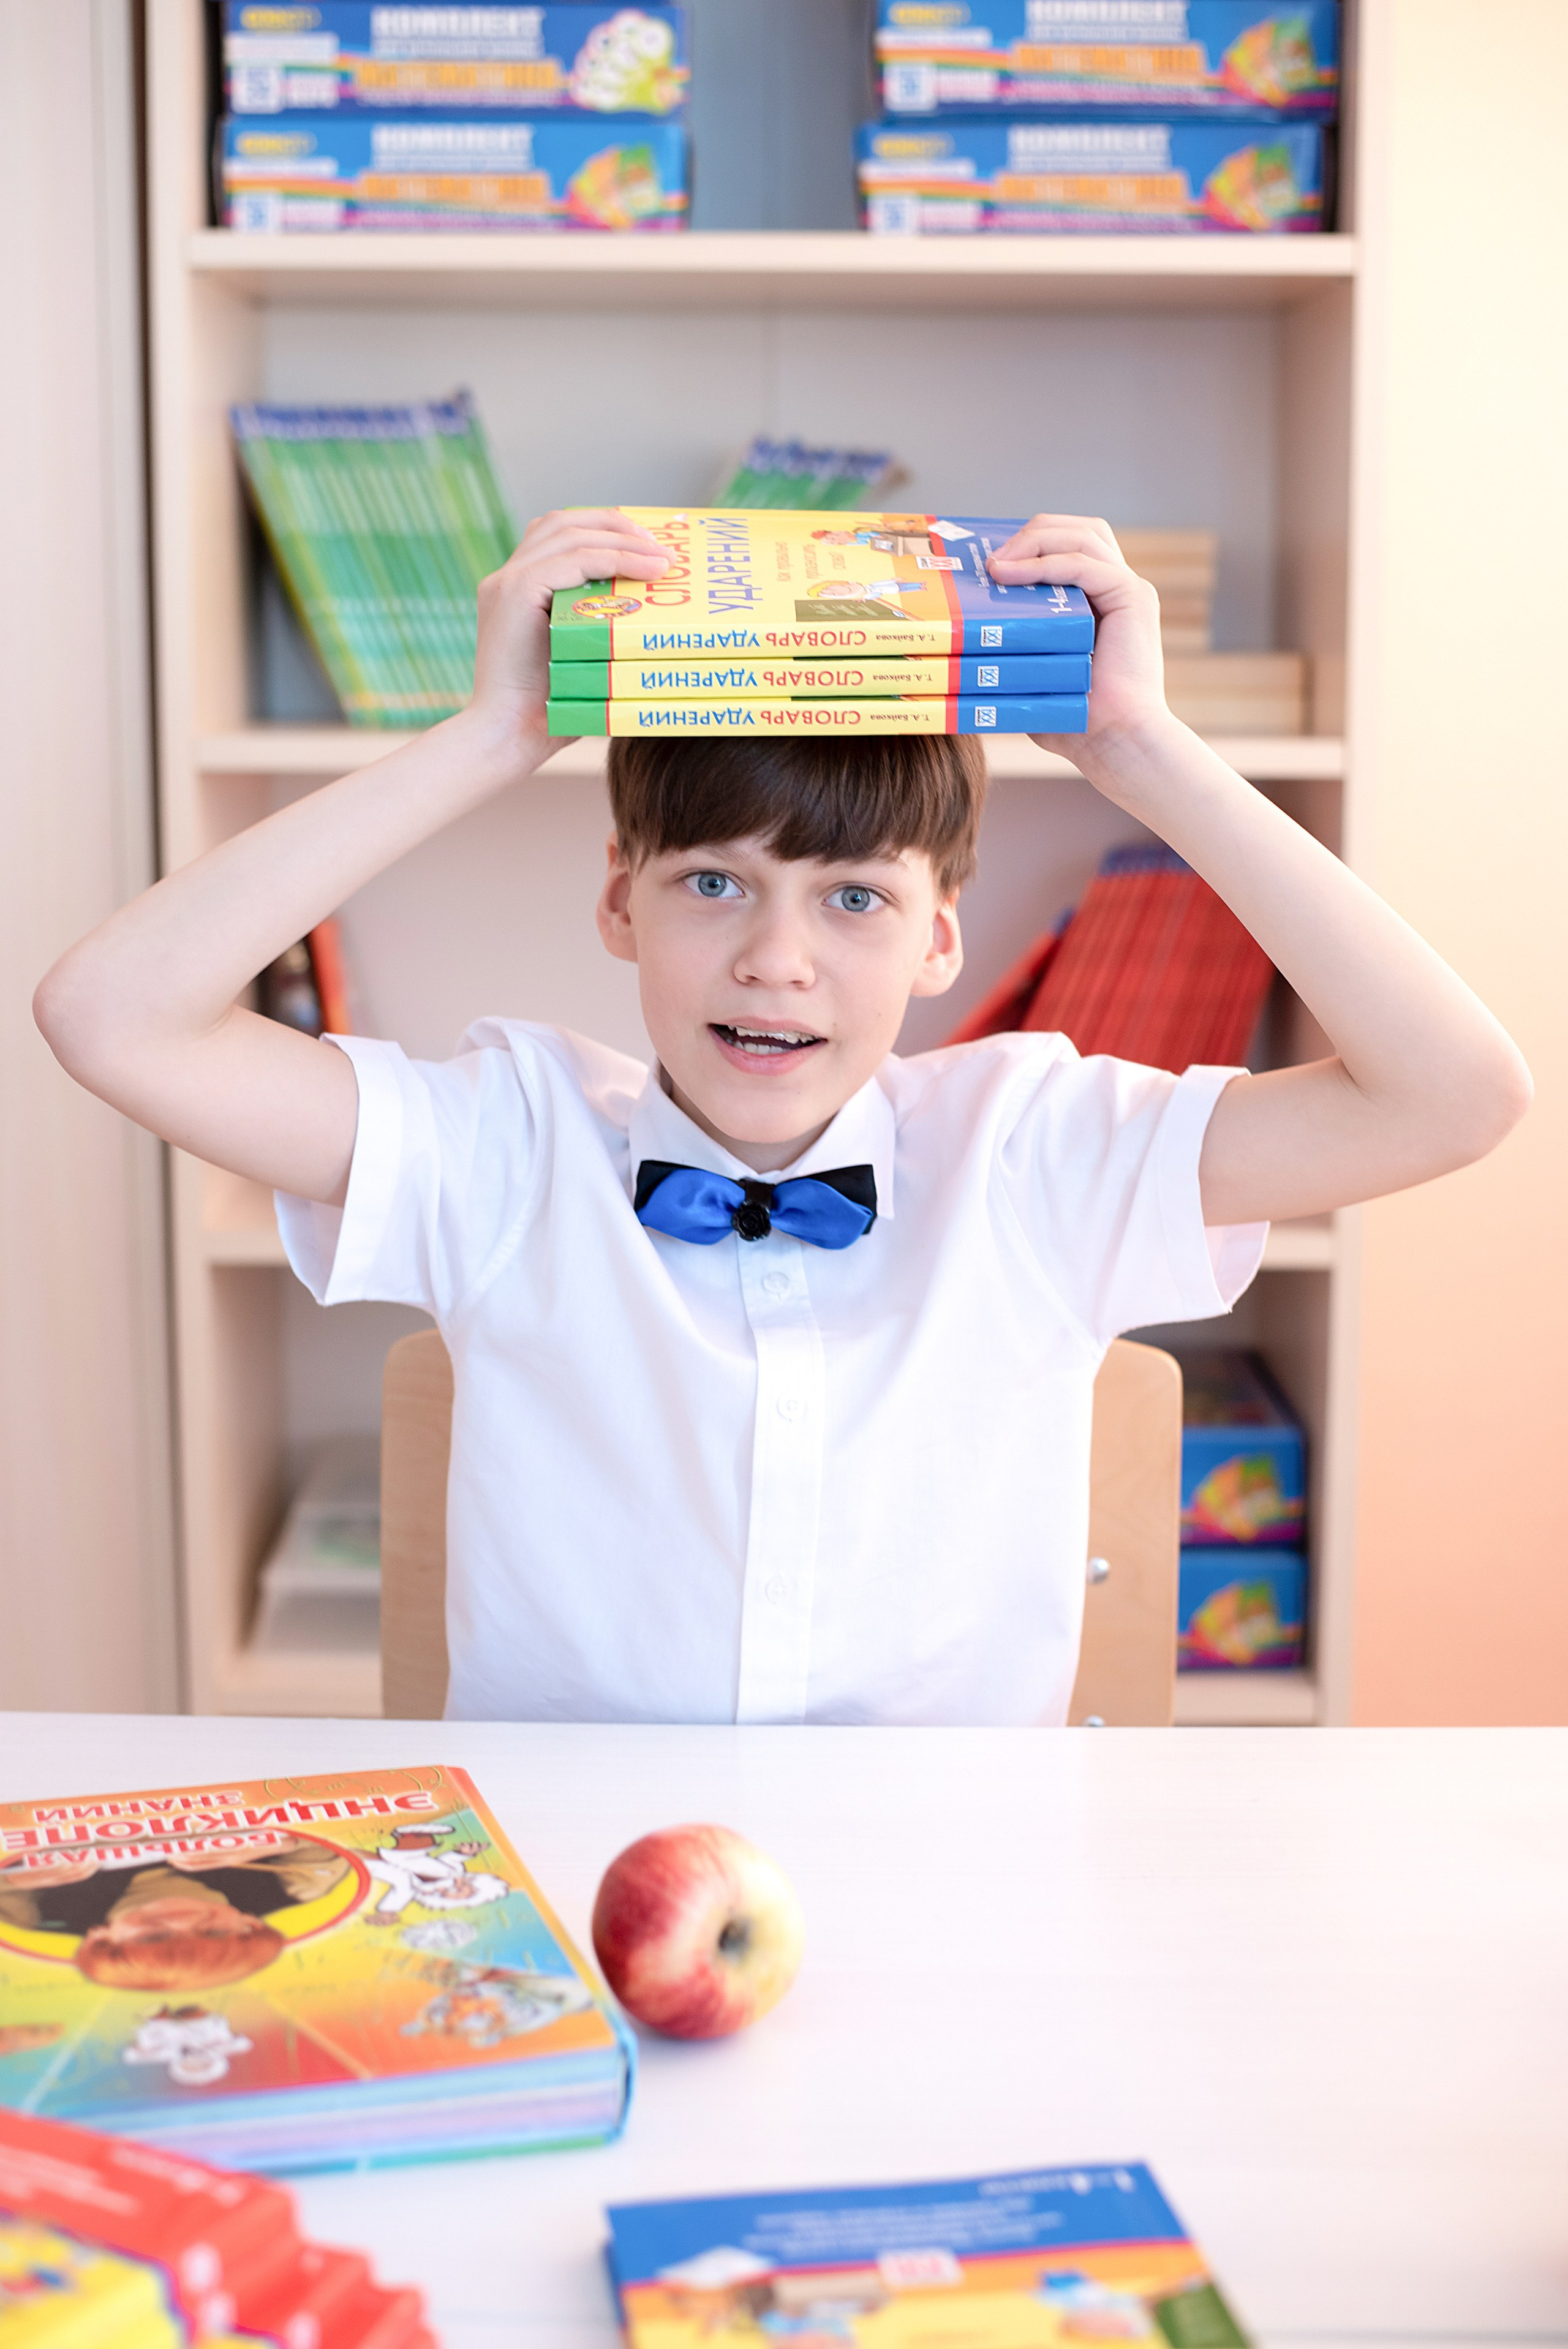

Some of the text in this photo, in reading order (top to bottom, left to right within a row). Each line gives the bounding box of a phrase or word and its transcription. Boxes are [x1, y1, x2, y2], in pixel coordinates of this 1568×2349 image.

[698, 518, 763, 614] УДАРЕНИЙ
[643, 628, 761, 651] УДАРЕНИЙ
[765, 630, 867, 647] СЛОВАРЬ
[876, 634, 914, 643] Байкова
[641, 667, 758, 690] УДАРЕНИЙ
[763, 670, 864, 687] СЛОВАРЬ
[873, 674, 911, 682] Байкова
[638, 706, 756, 728] УДАРЕНИЙ
[760, 710, 861, 725] СЛОВАРЬ
[870, 714, 908, 723] Байкова
[34, 1790, 244, 1825] ЗНАНИЙ
[2, 1792, 437, 1850] ЭНЦИКЛОПЕ
[24, 1831, 282, 1869] БОЛЬШАЯ
